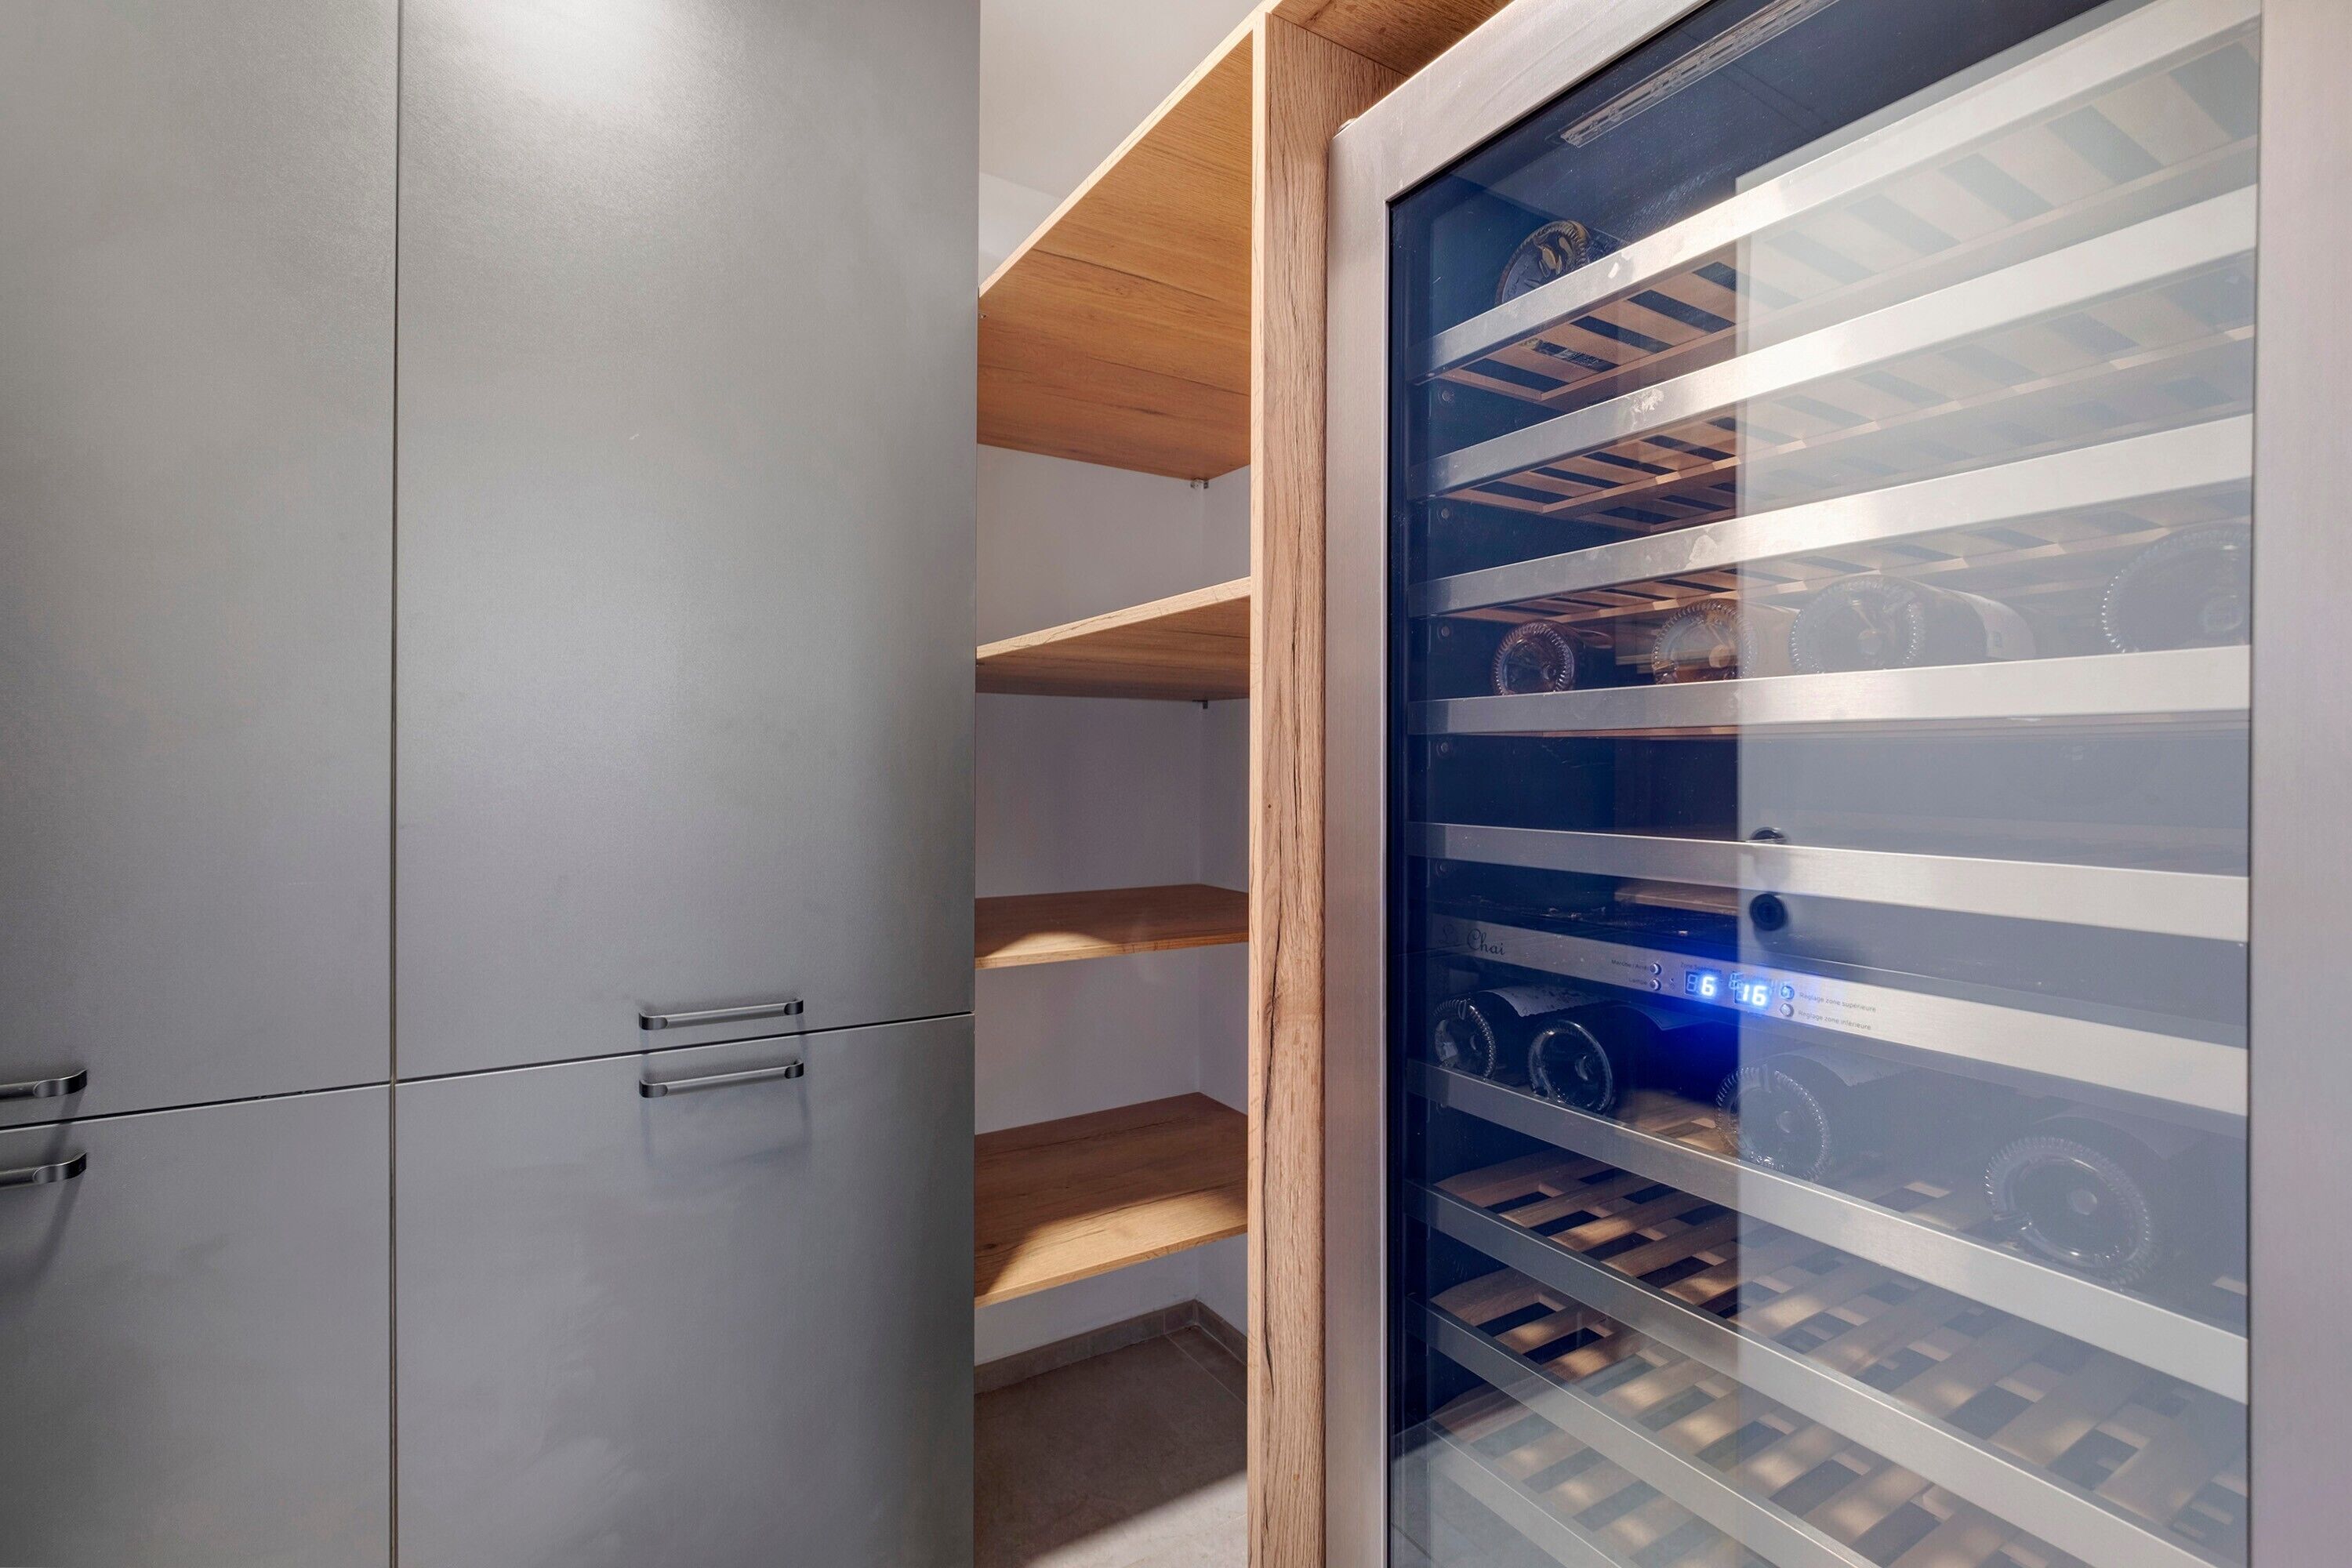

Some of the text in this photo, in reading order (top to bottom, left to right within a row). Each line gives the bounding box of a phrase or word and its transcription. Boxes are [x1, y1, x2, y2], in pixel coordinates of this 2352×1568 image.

[1467, 928, 1505, 955] Chai
[1700, 975, 1716, 996] 6
[1742, 984, 1767, 1007] 16
